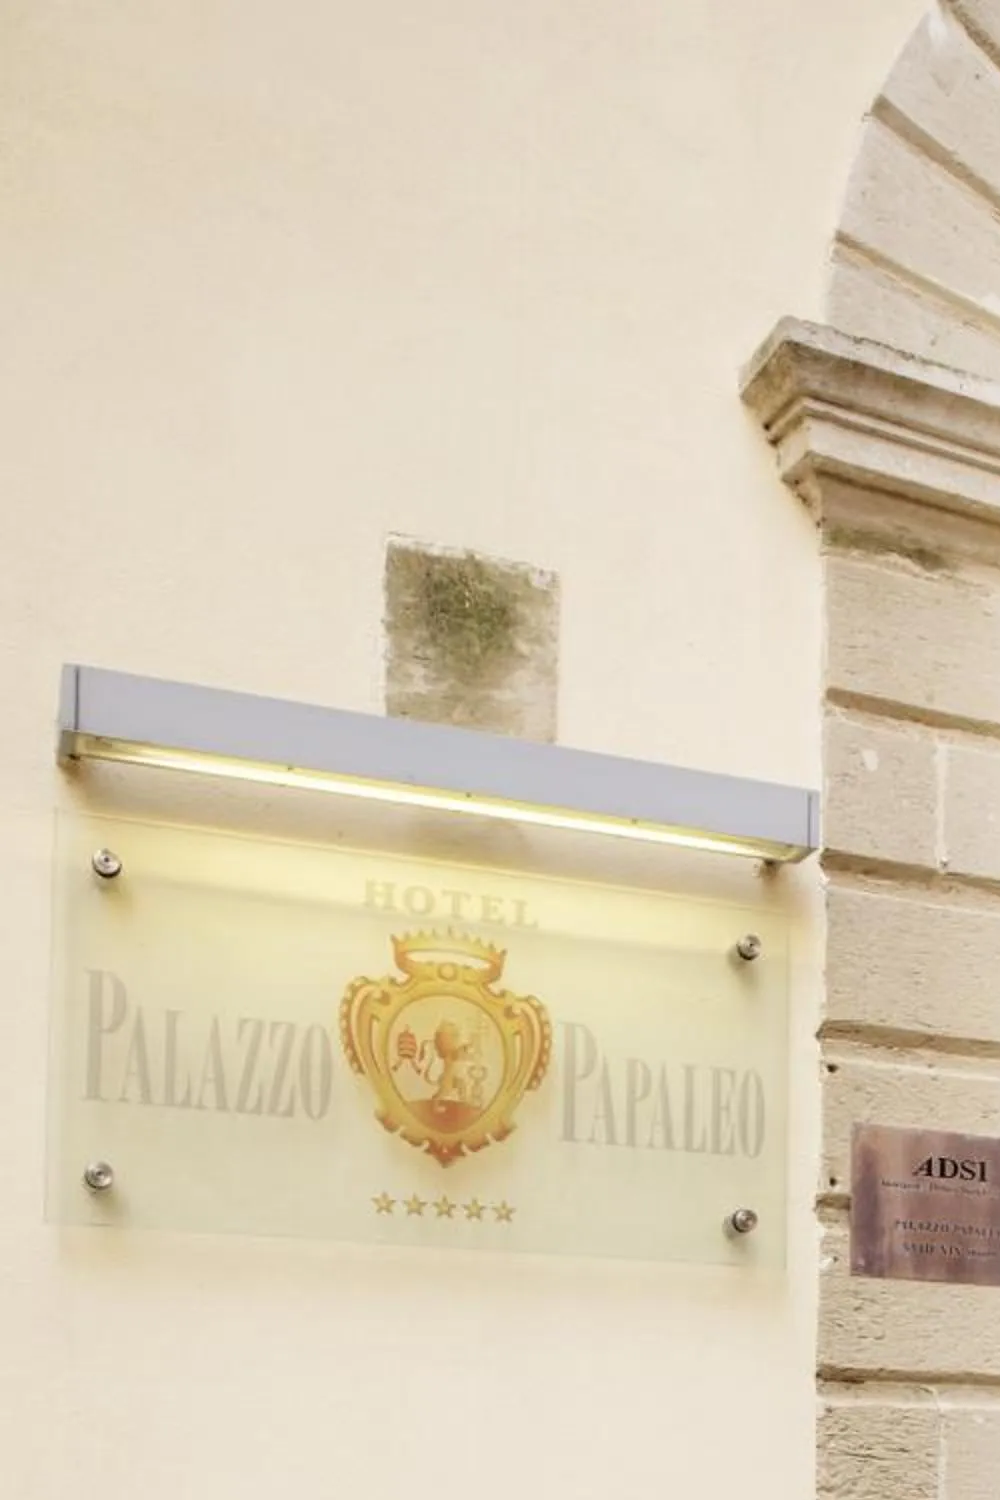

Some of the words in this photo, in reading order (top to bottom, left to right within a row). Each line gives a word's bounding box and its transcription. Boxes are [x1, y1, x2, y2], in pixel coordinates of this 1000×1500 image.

[364, 879, 538, 929] HOTEL
[81, 968, 333, 1121] PALAZZO
[559, 1021, 766, 1160] PAPALEO
[912, 1156, 989, 1183] ADSI
